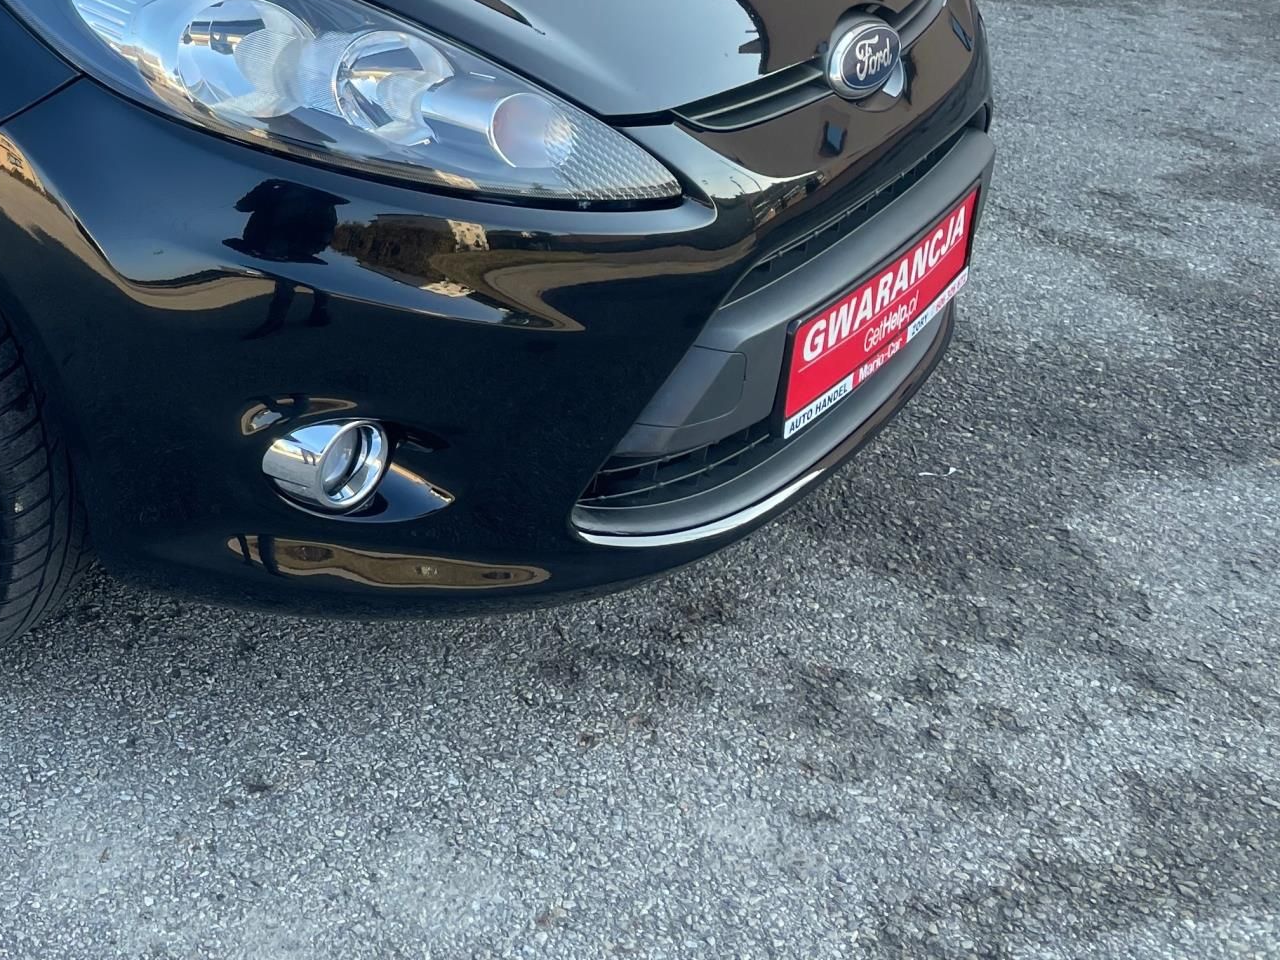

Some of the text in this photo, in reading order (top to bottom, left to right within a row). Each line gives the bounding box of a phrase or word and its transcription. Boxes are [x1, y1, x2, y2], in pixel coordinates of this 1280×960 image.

[855, 34, 892, 81] Ford
[803, 205, 966, 362] GWARANCJA
[864, 289, 919, 352] GetHelp.pl
[789, 408, 813, 434] AUTO
[815, 384, 848, 415] HANDEL
